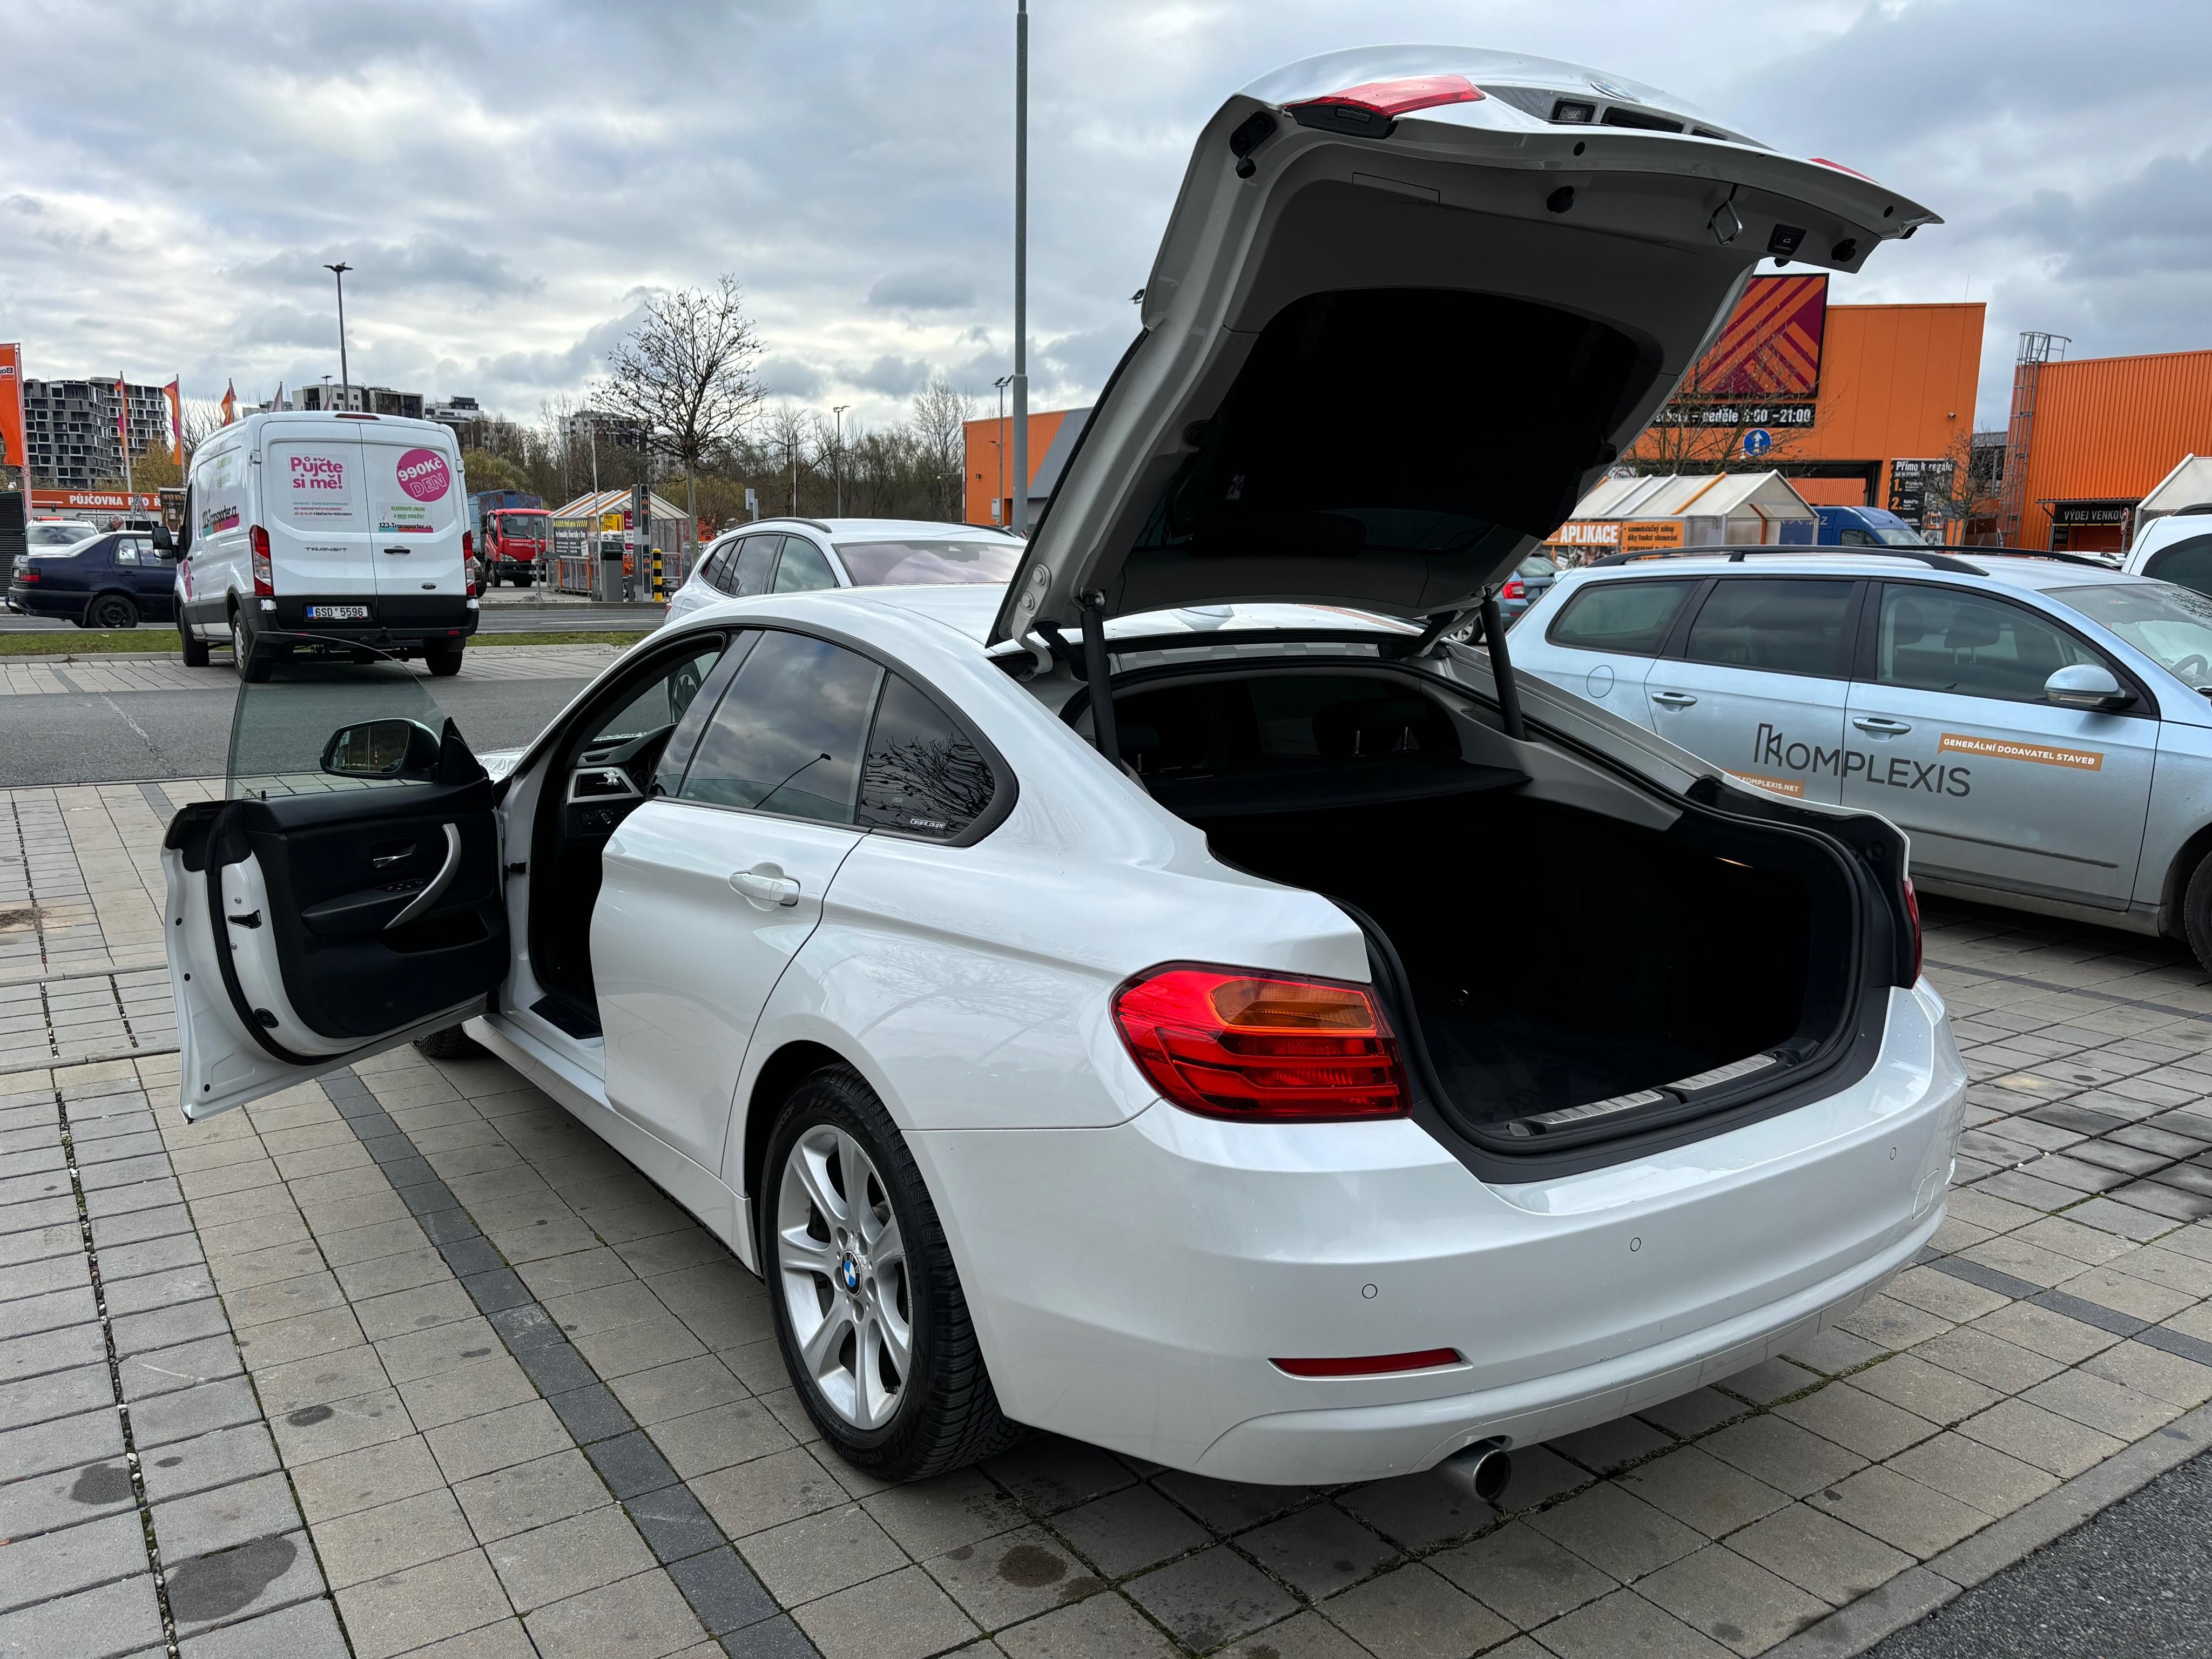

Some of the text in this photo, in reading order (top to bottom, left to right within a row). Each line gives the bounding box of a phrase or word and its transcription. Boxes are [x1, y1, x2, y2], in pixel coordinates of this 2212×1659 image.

[1702, 408, 1738, 423] neděle
[290, 456, 343, 477] Půjčte
[397, 457, 442, 482] 990Kč
[1896, 461, 1918, 471] Přímo
[1920, 462, 1926, 471] k
[293, 474, 343, 489] si mě!
[409, 473, 447, 497] DEN
[69, 493, 123, 505] PŮJČOVNA
[128, 496, 150, 507] PO
[2065, 509, 2089, 521] VÝDEJ
[1560, 525, 1618, 543] APLIKACE
[315, 608, 333, 616] 6SD
[340, 608, 363, 616] 5596
[1754, 723, 1971, 797] KOMPLEXIS
[1944, 738, 2095, 765] GENERÁLNÍ DODAVATEL STAVEB
[844, 1253, 860, 1273] BMW
